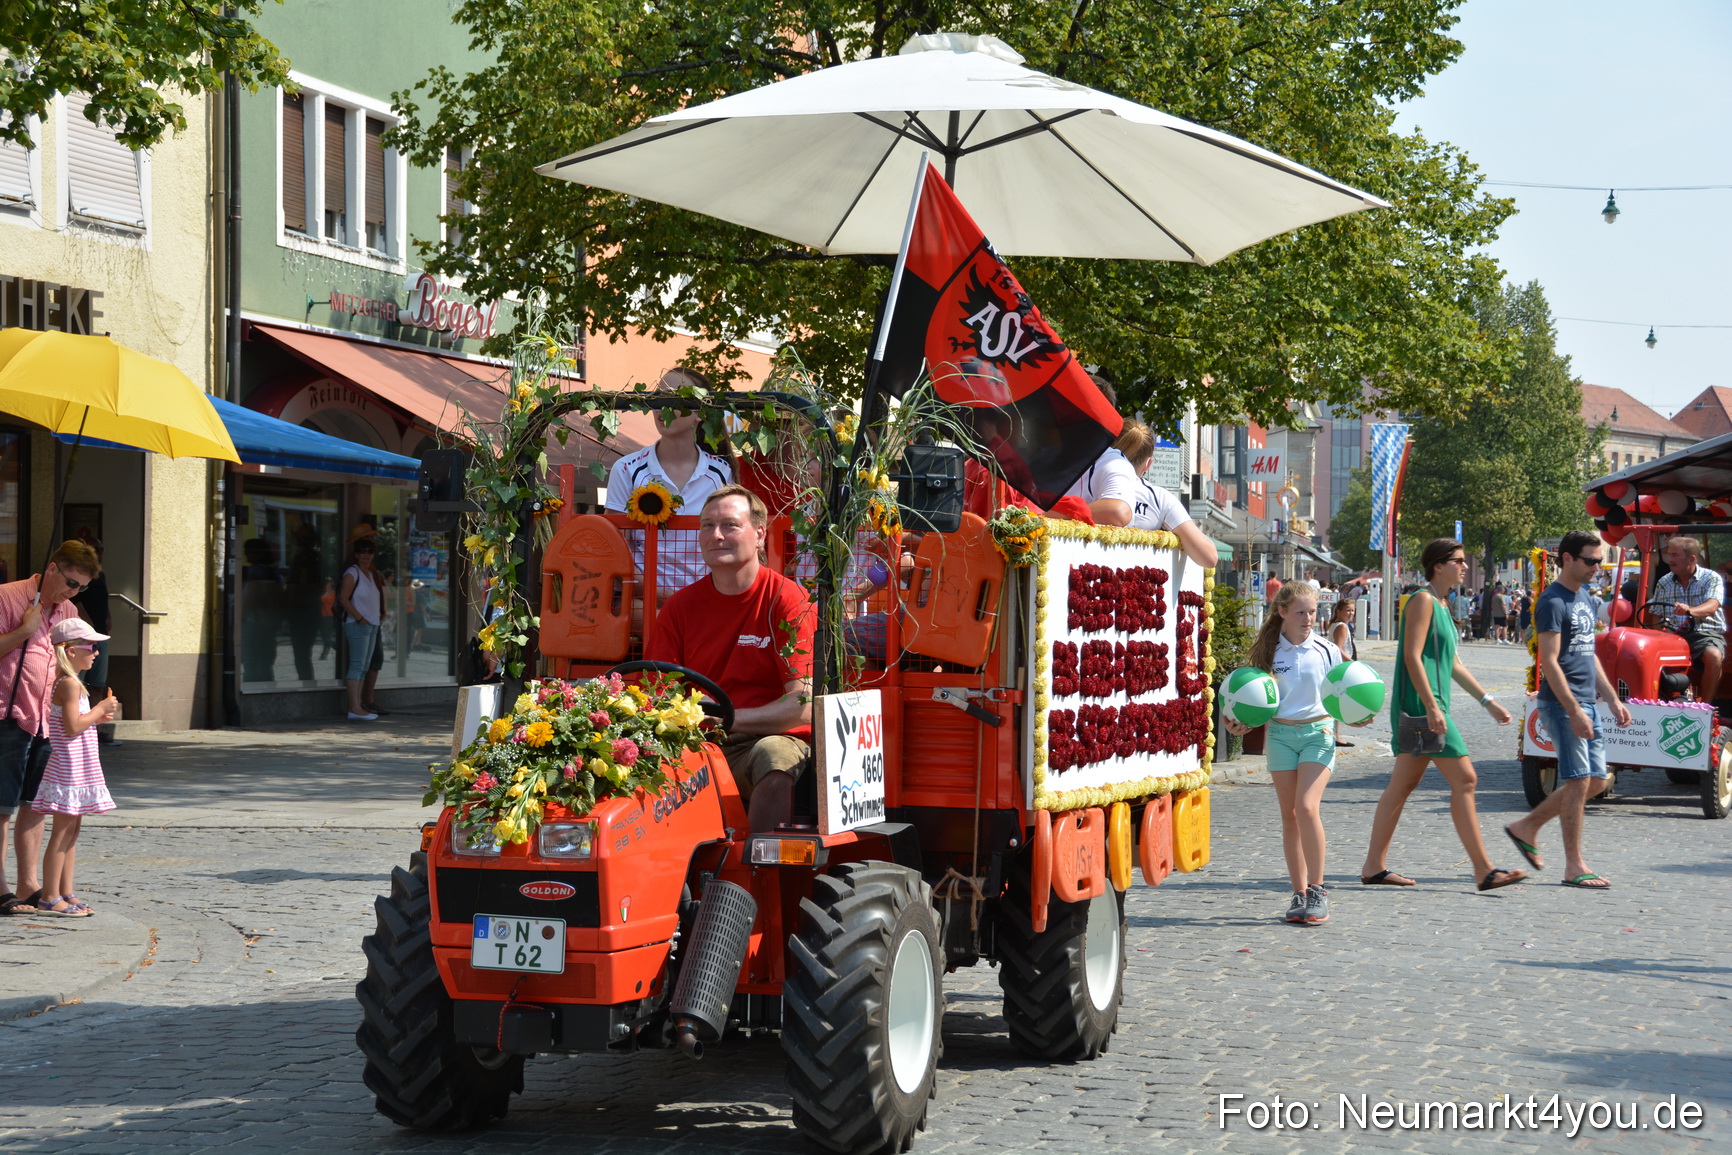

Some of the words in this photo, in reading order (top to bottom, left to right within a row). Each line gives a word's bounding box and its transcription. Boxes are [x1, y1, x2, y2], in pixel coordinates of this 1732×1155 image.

[330, 291, 397, 322] METZGEREI
[410, 273, 500, 342] Bögerl
[966, 301, 1042, 364] ASV
[1251, 455, 1280, 475] H&M
[857, 713, 882, 751] ASV
[1618, 738, 1636, 748] Berg
[1663, 733, 1682, 748] BERG
[1676, 737, 1697, 757] SV
[861, 752, 884, 785] 1860
[522, 886, 571, 896] GOLDONI
[478, 929, 485, 938] D
[515, 921, 530, 943] N
[494, 943, 508, 965] T
[514, 944, 542, 968] 62
